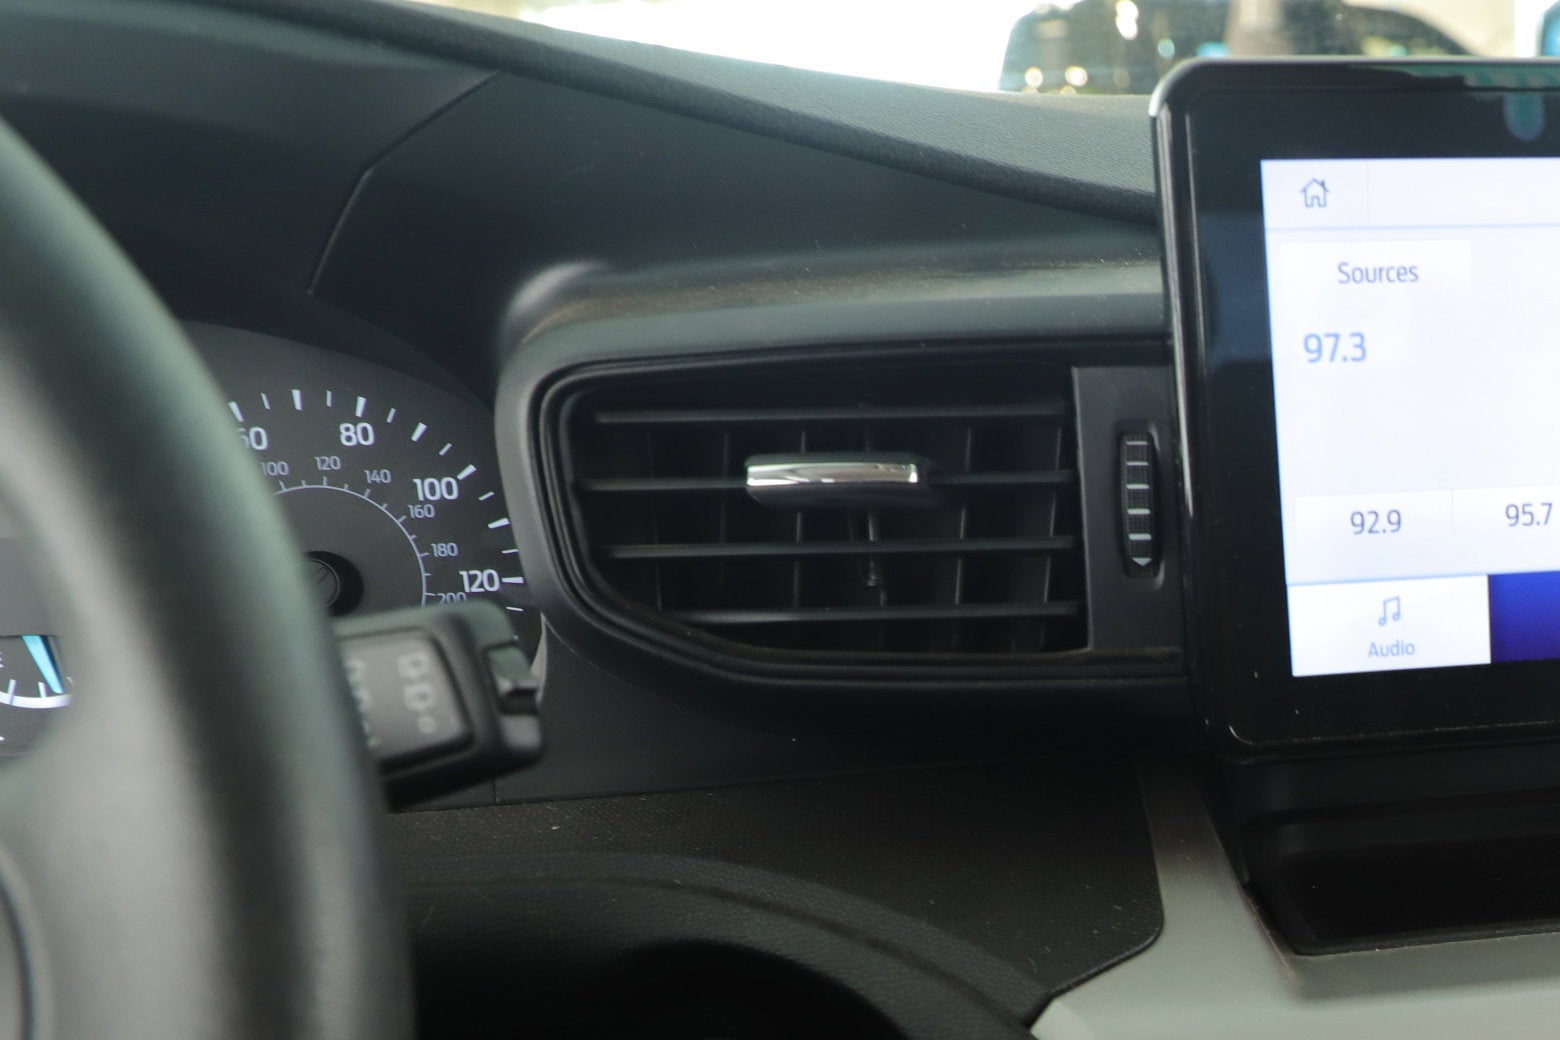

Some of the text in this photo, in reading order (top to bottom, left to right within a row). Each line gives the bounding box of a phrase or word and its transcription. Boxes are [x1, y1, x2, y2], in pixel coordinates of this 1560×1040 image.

[1337, 261, 1419, 285] Sources
[1303, 332, 1367, 364] 97.3
[339, 422, 375, 447] 80
[314, 456, 342, 471] 120
[364, 469, 392, 484] 140
[412, 477, 459, 501] 100
[407, 504, 436, 519] 160
[1350, 509, 1402, 535] 92.9
[1504, 502, 1553, 527] 95.7
[430, 542, 459, 557] 180
[458, 569, 500, 593] 120
[1367, 641, 1416, 658] Audio
